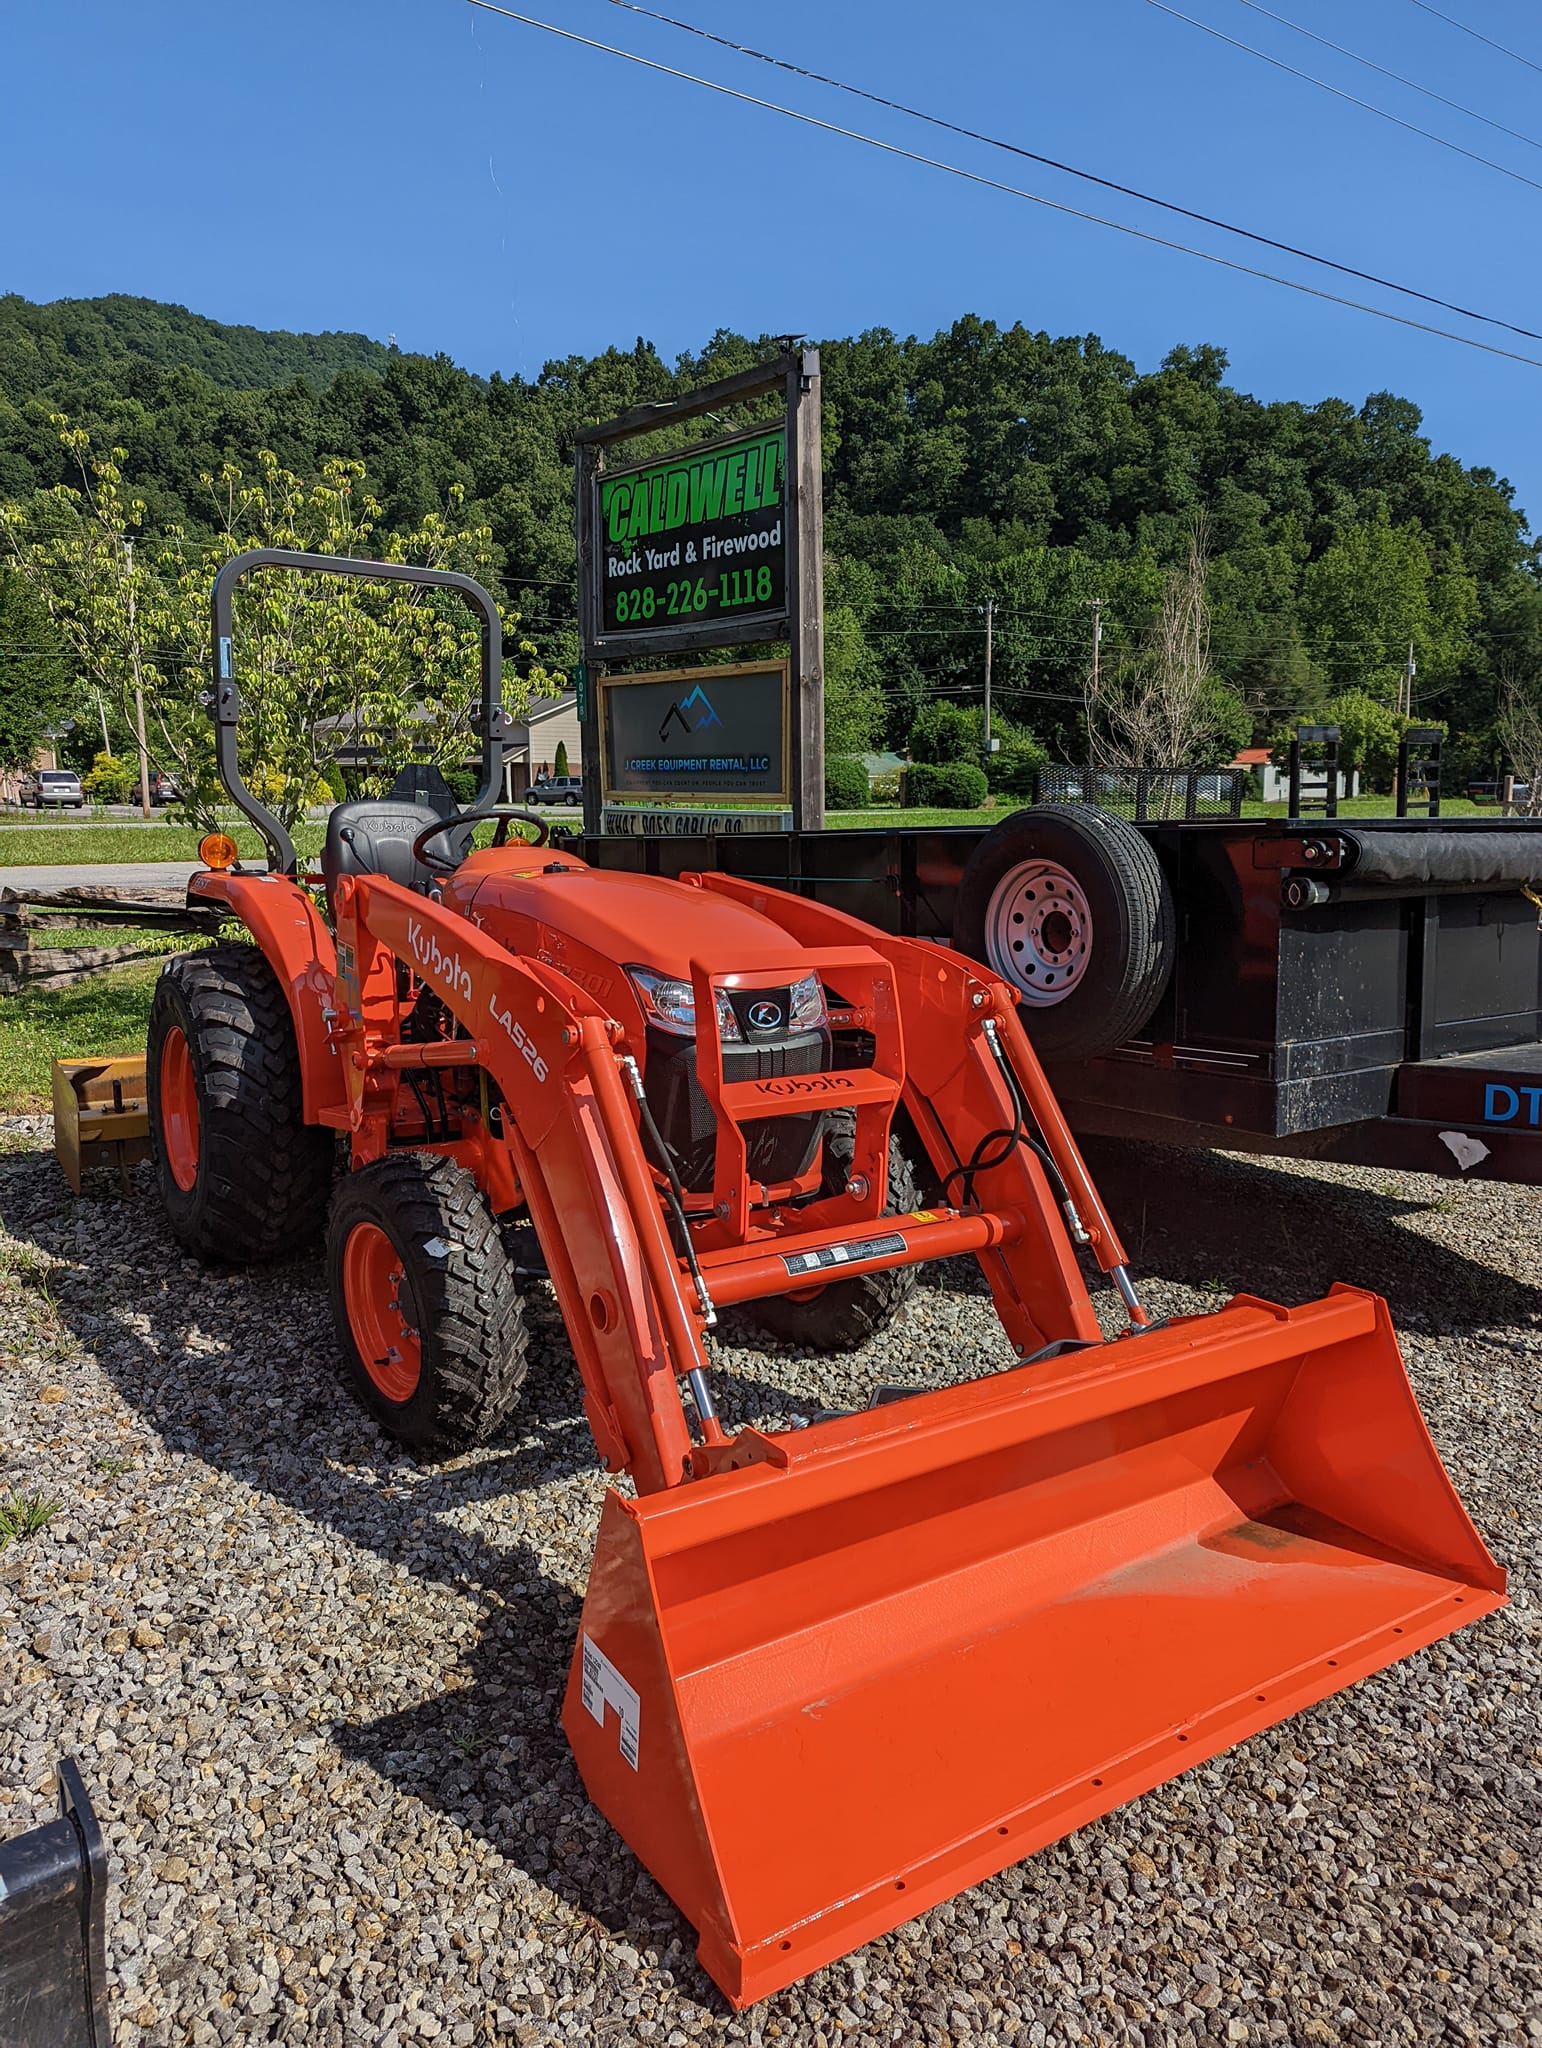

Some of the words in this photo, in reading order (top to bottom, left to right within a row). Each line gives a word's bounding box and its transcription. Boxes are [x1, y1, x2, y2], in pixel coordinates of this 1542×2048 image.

[607, 440, 780, 543] CALDWELL
[608, 552, 642, 578] Rock
[645, 543, 680, 571] Yard
[685, 541, 697, 564] &
[702, 520, 781, 561] Firewood
[615, 565, 773, 622] 828-226-1118
[631, 760, 657, 771] CREEK
[658, 759, 708, 771] EQUIPMENT
[709, 758, 749, 772] RENTAL,
[751, 758, 769, 770] LLC
[366, 821, 417, 832] Kubota
[606, 814, 636, 834] WHAT
[408, 917, 472, 1002] Kubota
[489, 993, 549, 1082] LA526
[755, 1076, 855, 1096] Kubota
